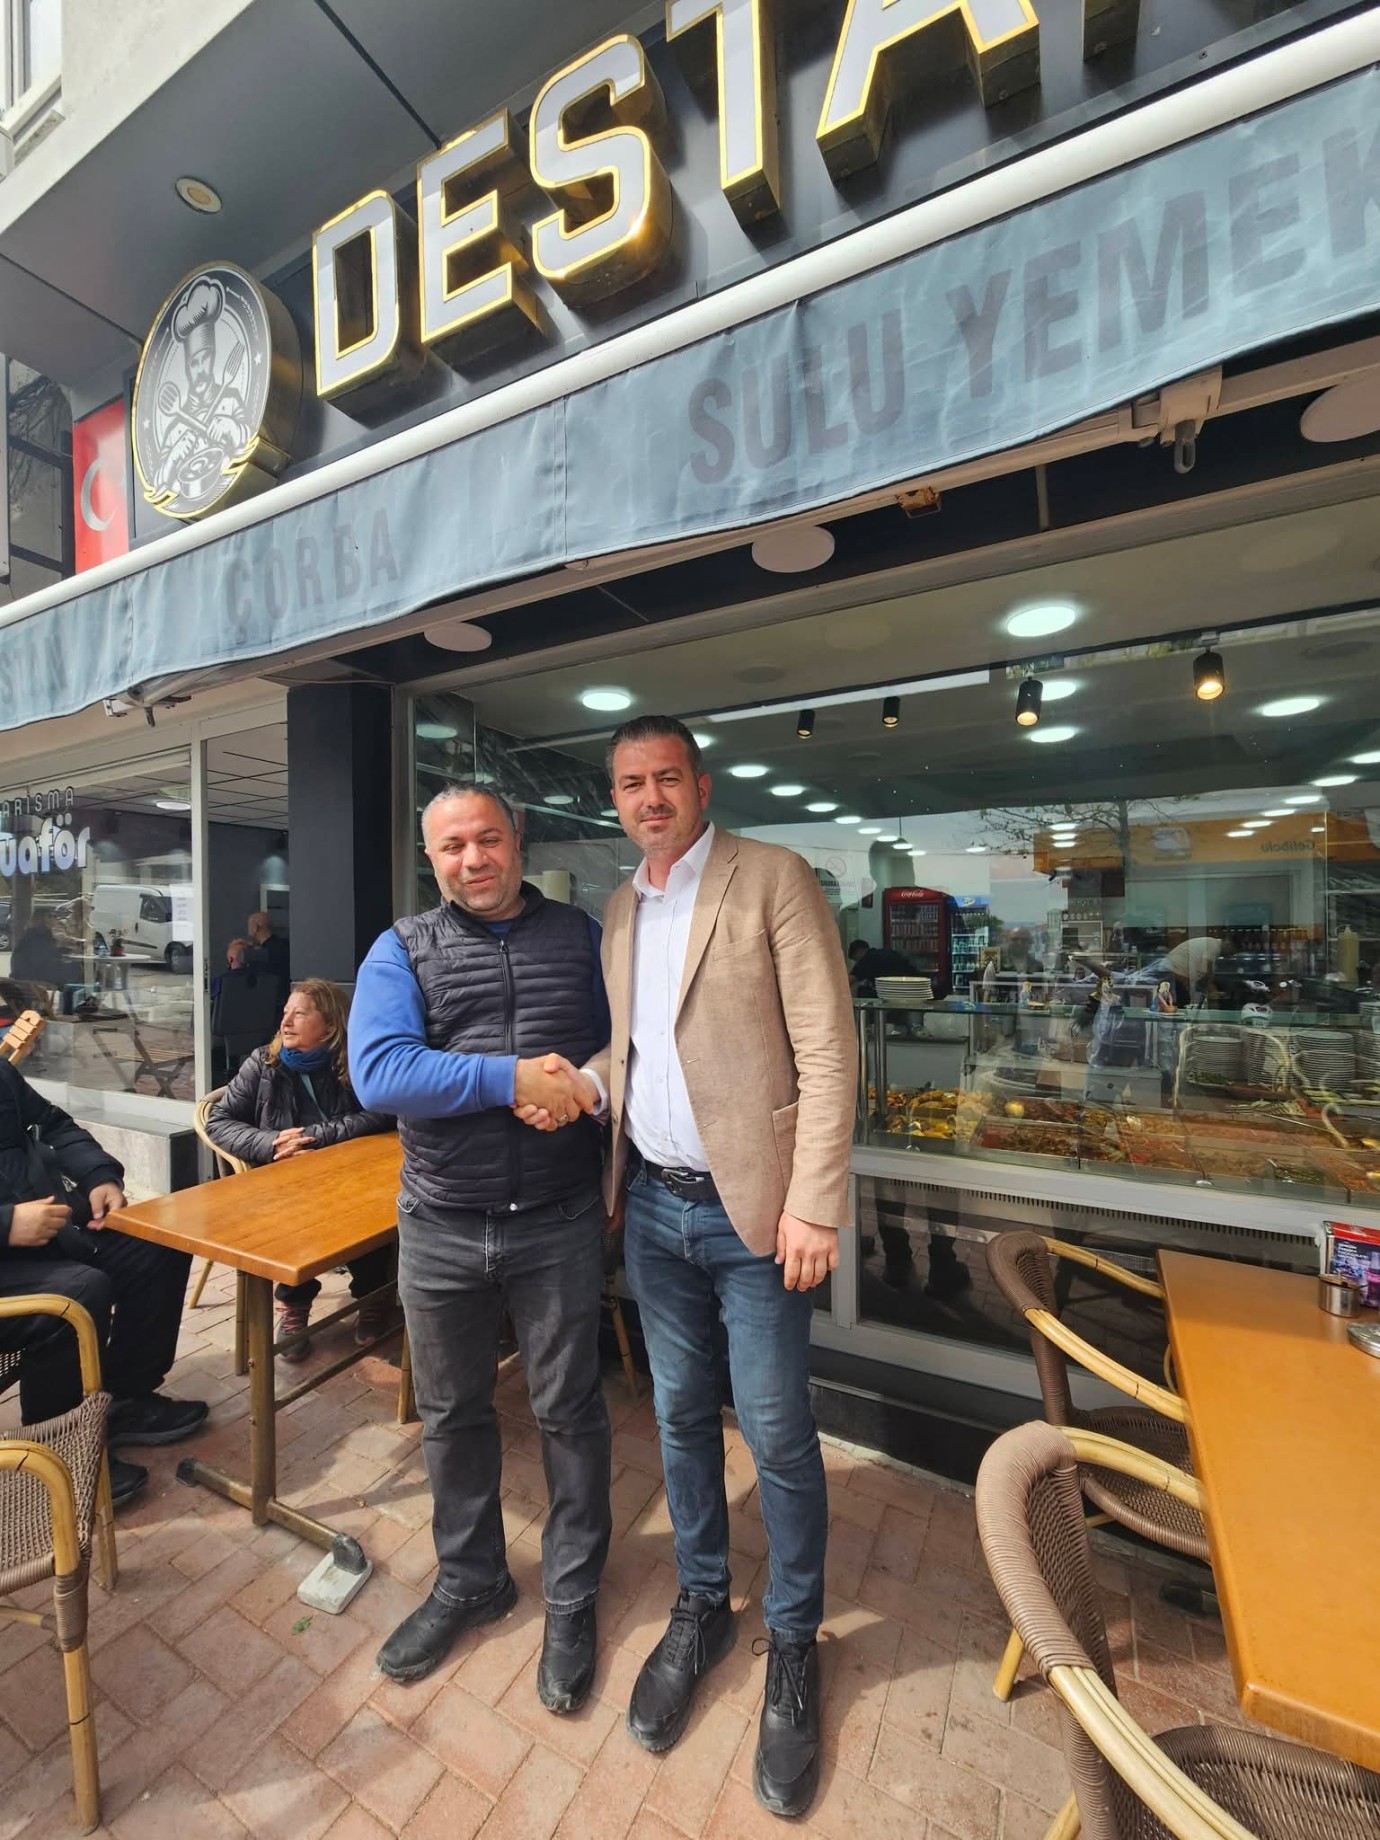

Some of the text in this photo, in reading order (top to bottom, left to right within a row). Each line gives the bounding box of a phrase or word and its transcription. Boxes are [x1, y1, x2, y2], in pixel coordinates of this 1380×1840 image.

[312, 0, 1060, 397] DESTA
[688, 122, 1380, 484] SULU YEMEK
